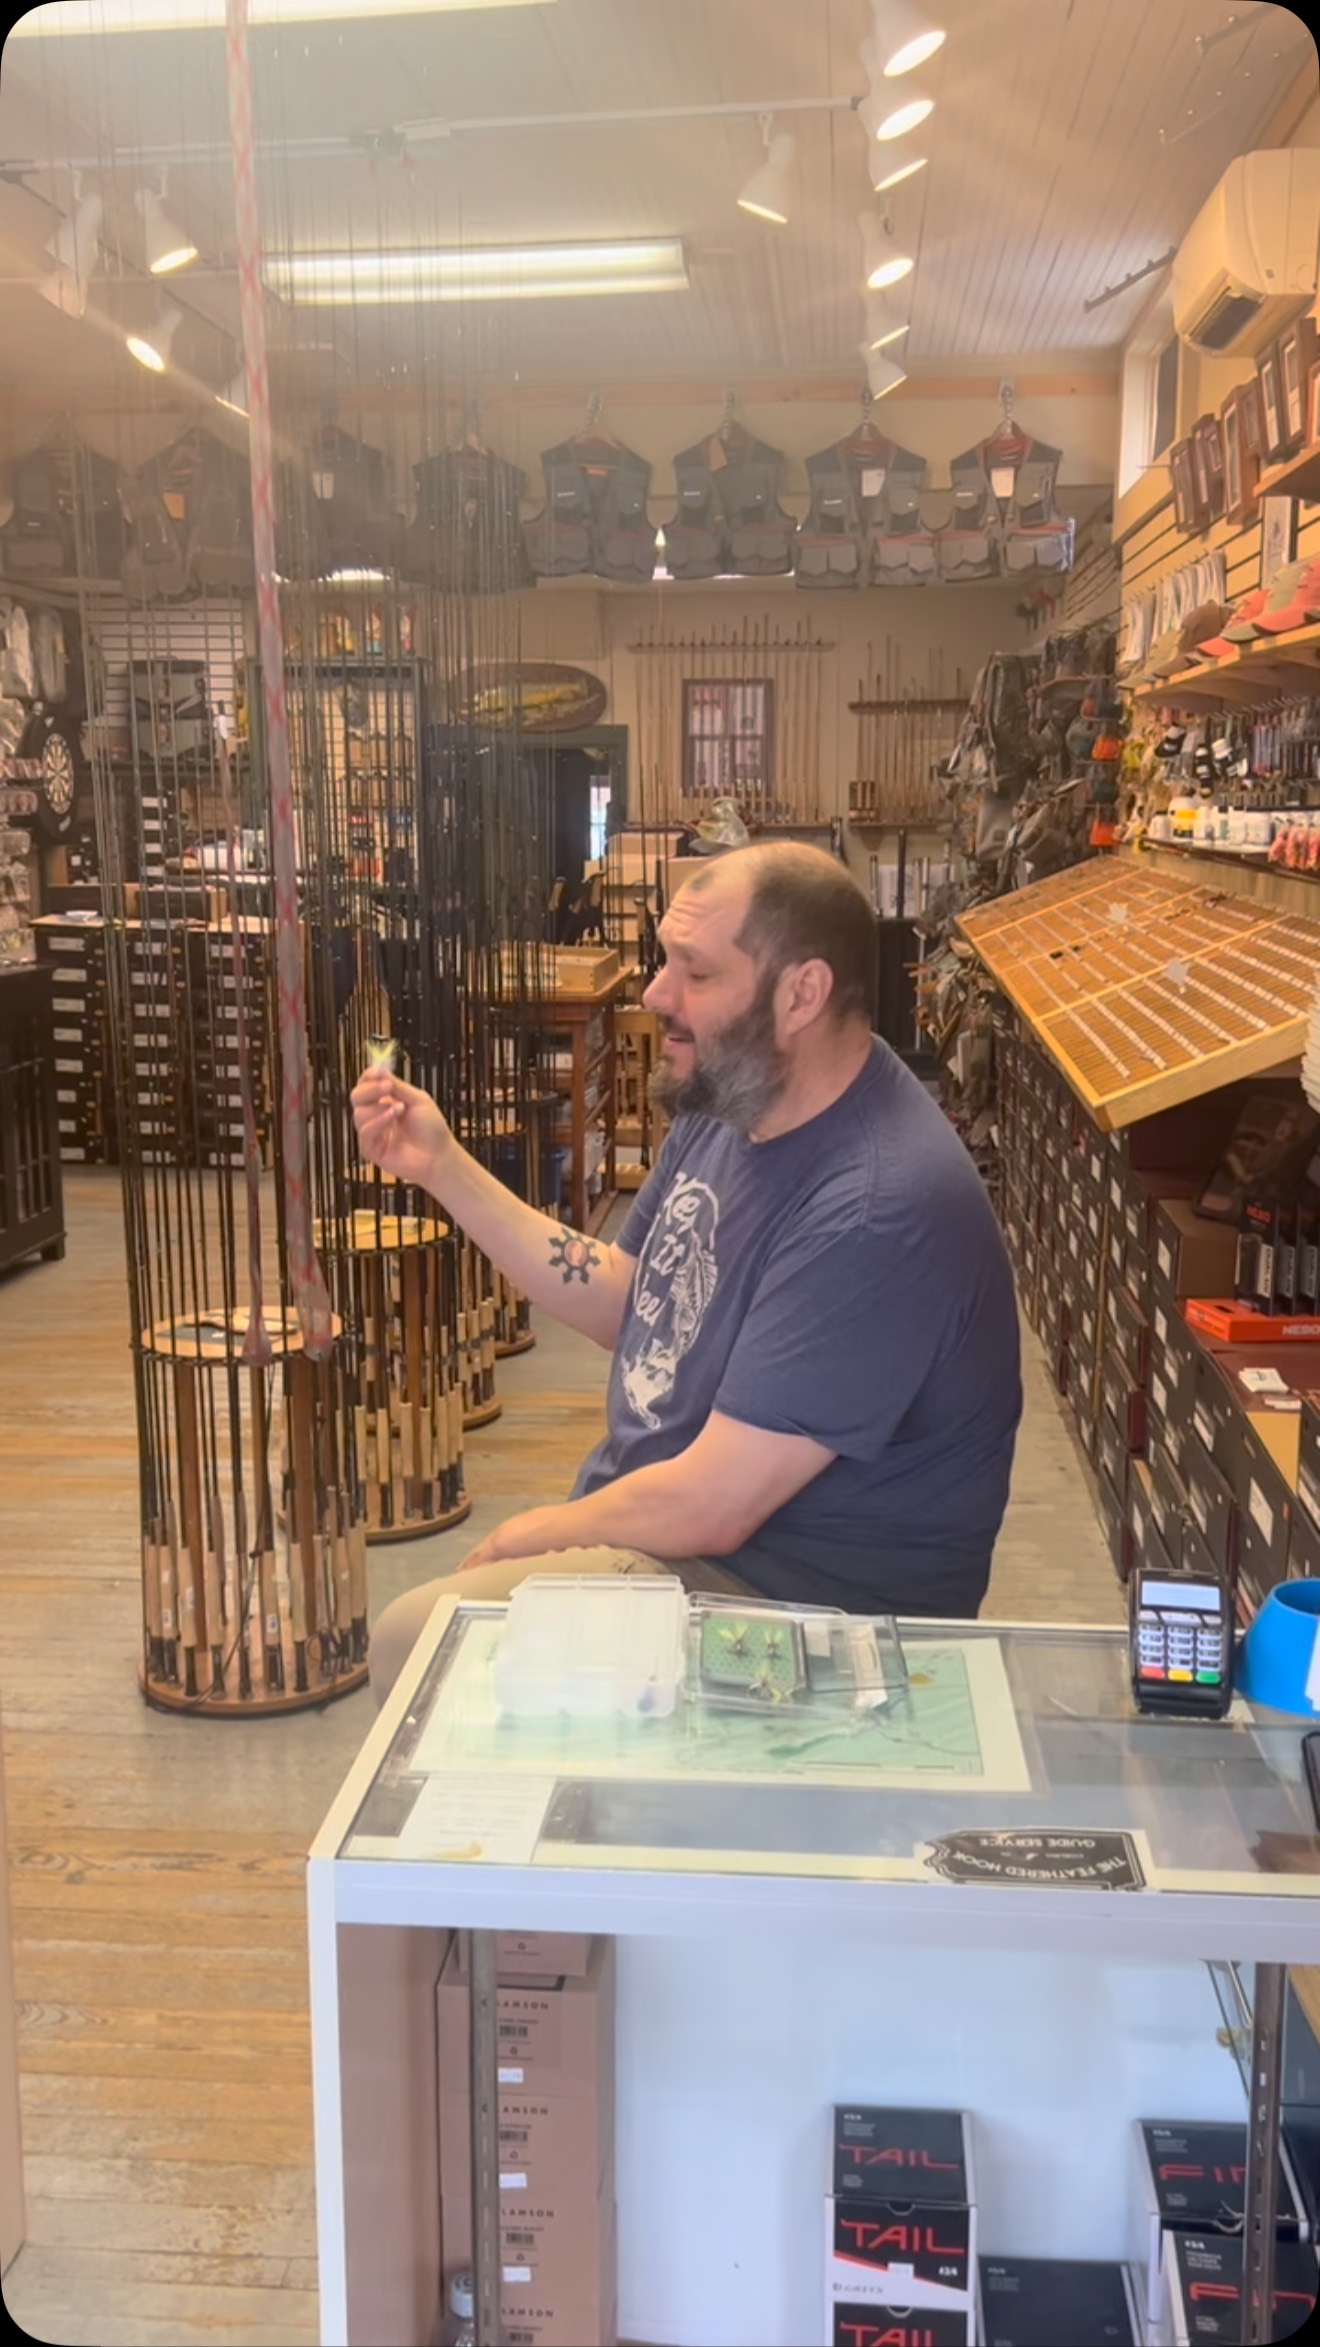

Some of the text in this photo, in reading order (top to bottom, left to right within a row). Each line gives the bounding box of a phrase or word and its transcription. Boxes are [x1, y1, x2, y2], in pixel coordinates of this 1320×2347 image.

[979, 1837, 1096, 1848] GUIDE SERVICE
[953, 1849, 1127, 1879] THE FEATHERED HOOK
[499, 2105, 549, 2115] AMSON
[839, 2144, 960, 2169] TAIL
[502, 2208, 554, 2218] LAMSON
[840, 2218, 965, 2255] TAIL
[501, 2307, 554, 2318] LAMSON
